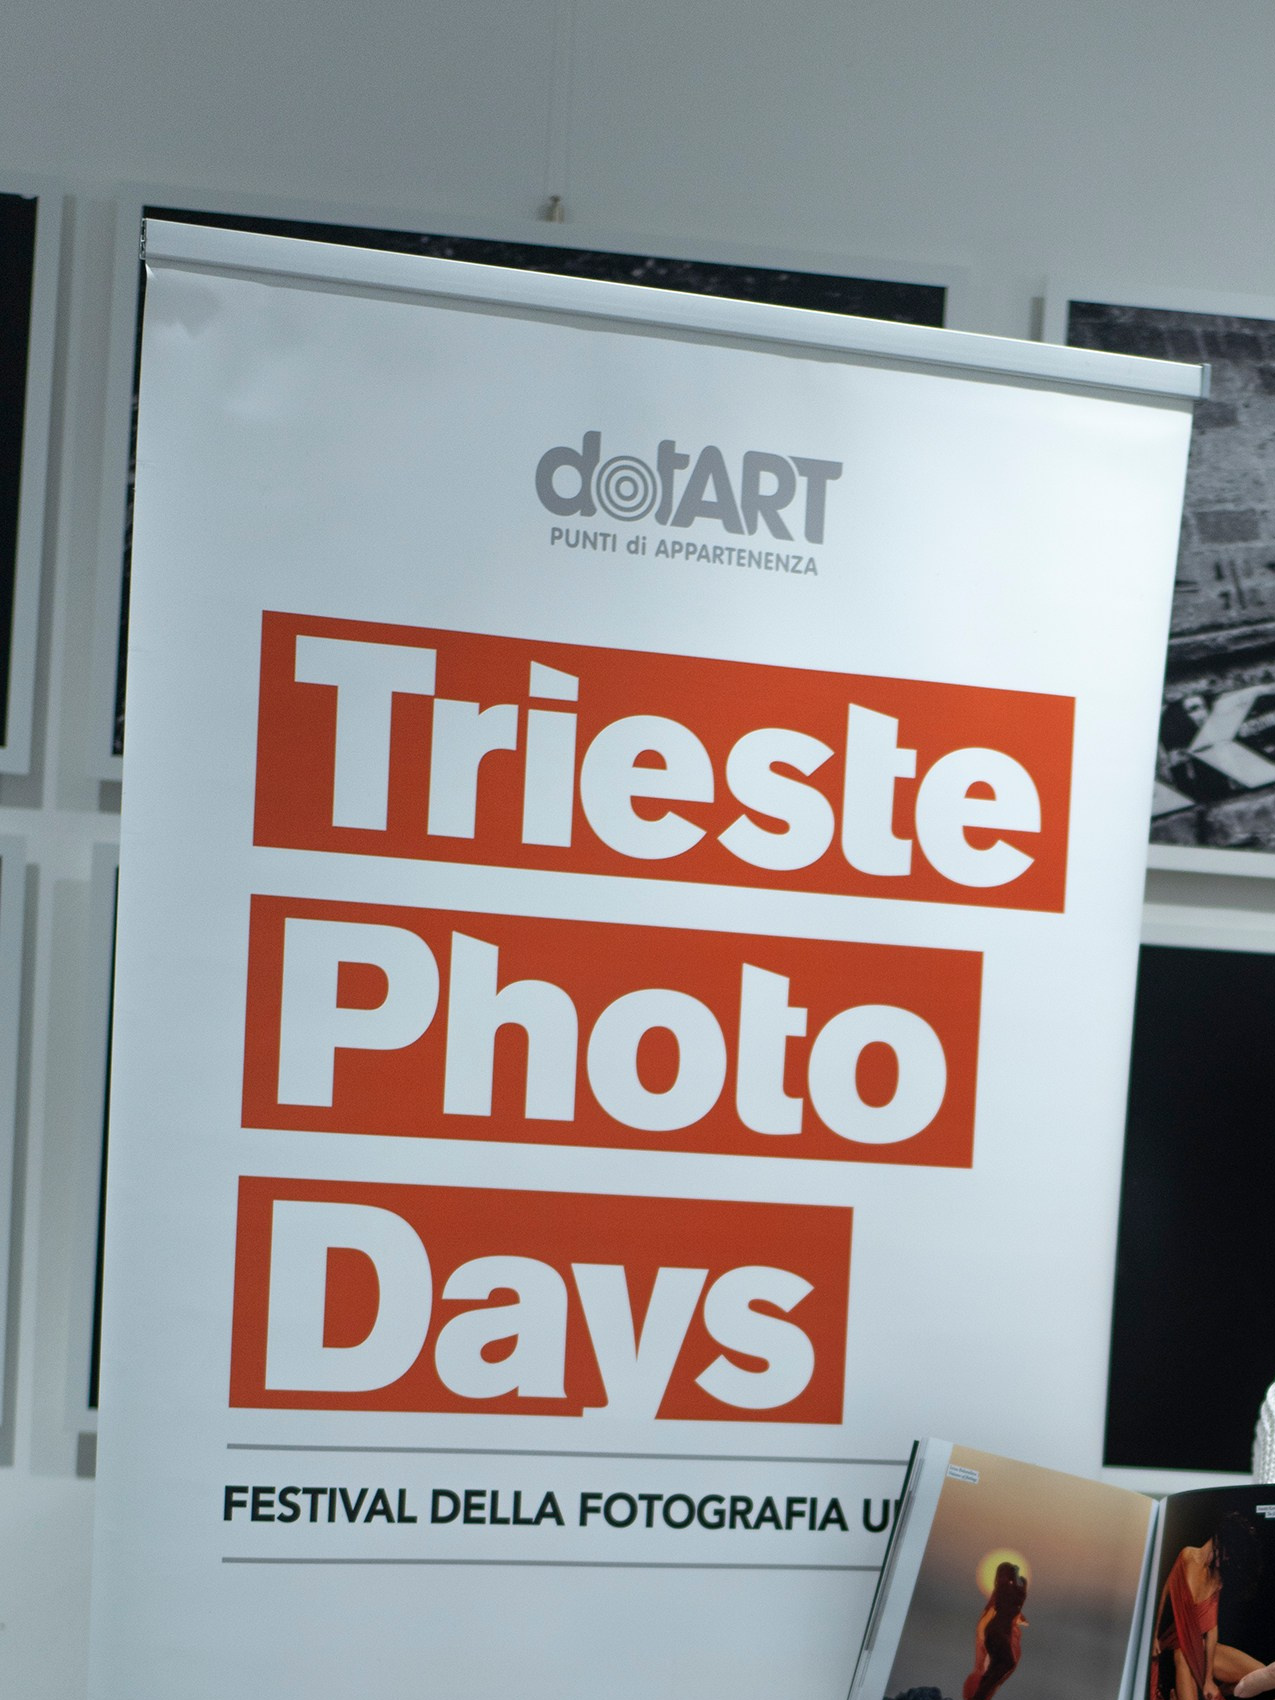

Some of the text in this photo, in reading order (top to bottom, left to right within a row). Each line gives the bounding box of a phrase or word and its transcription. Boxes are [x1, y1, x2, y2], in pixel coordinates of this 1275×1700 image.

[535, 430, 843, 545] dotART
[551, 527, 819, 577] PUNTI di APPARTENENZA
[294, 634, 1042, 889] Trieste
[276, 917, 948, 1146] Photo
[264, 1199, 816, 1421] Days
[222, 1485, 902, 1533] FESTIVAL DELLA FOTOGRAFIA U
